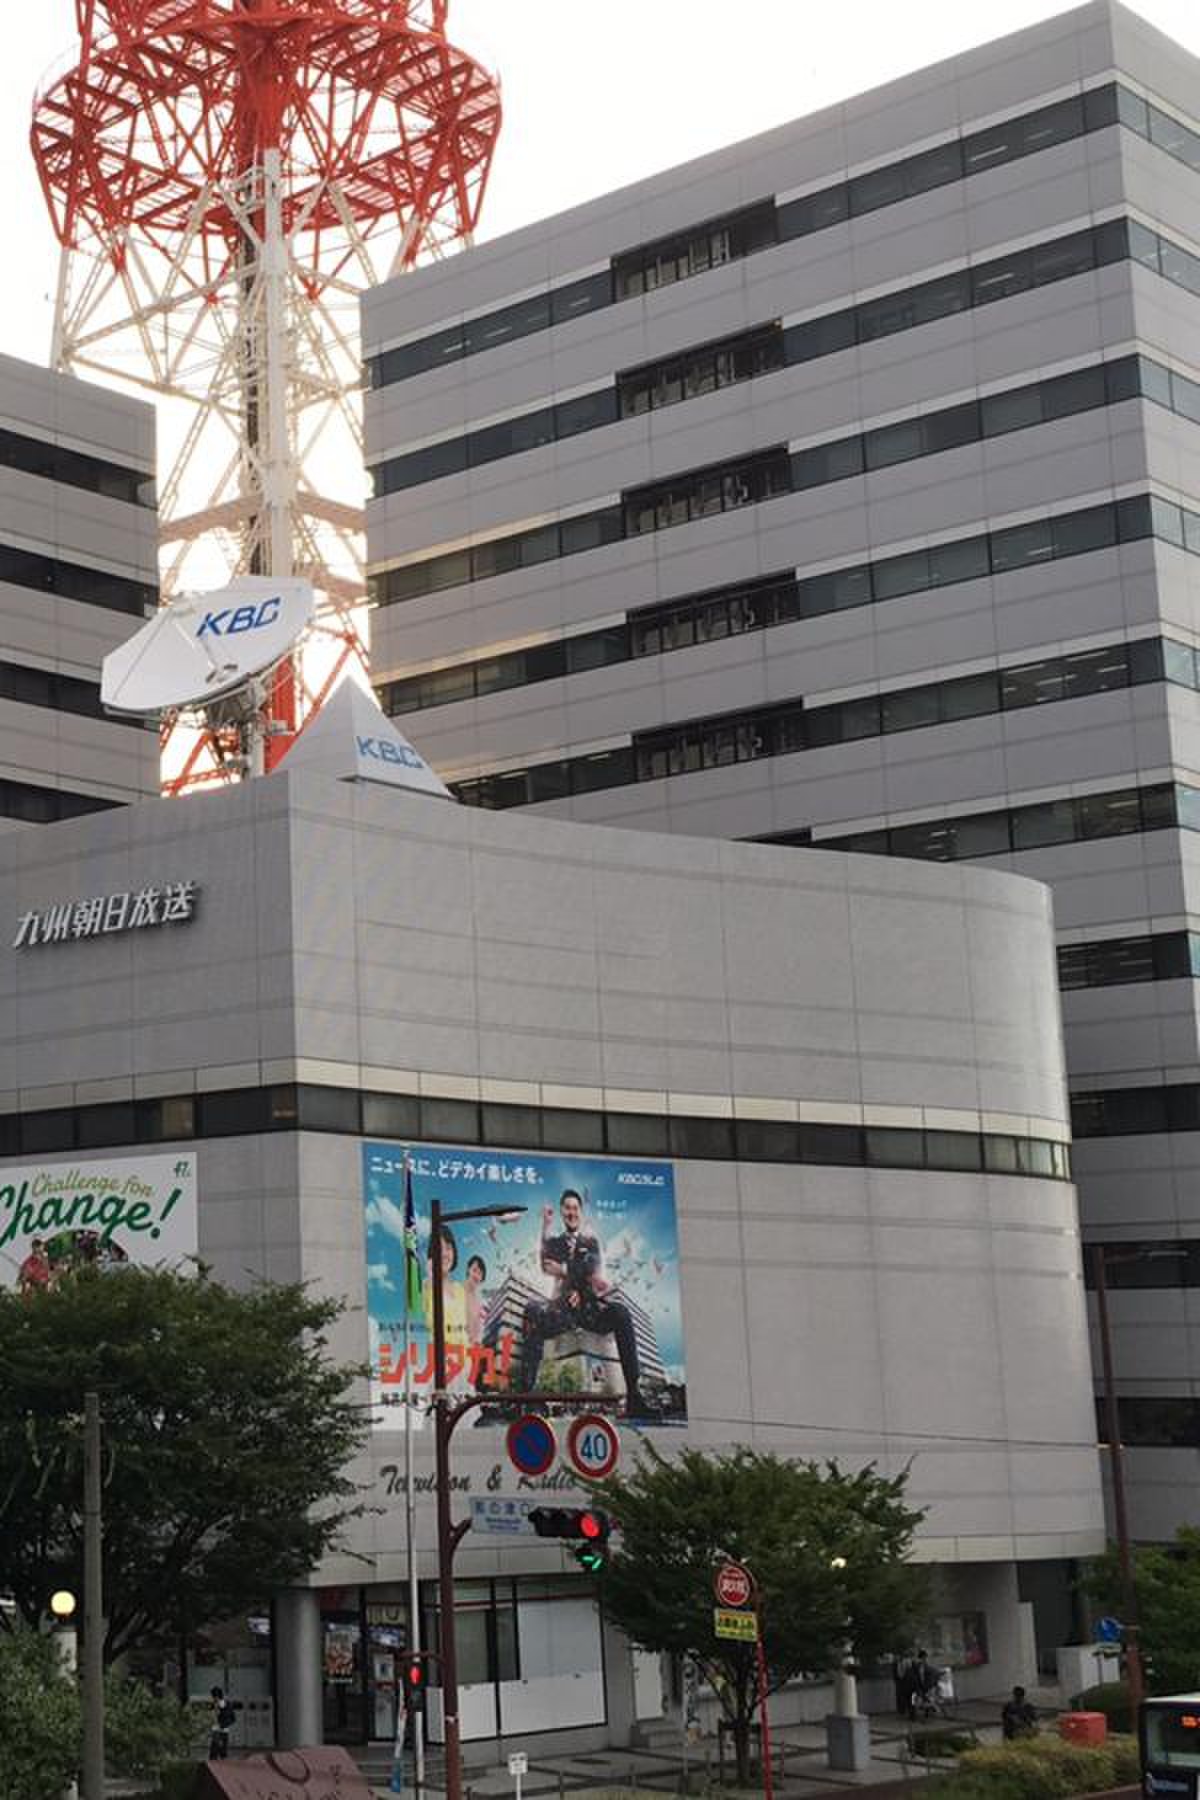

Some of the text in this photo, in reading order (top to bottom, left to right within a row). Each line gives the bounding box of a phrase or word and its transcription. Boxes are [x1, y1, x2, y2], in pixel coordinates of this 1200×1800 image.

[196, 596, 281, 637] KBC
[356, 734, 424, 769] KBC
[12, 880, 197, 949] 九州朝日放送
[31, 1169, 121, 1199] Challenge
[580, 1433, 609, 1462] 40
